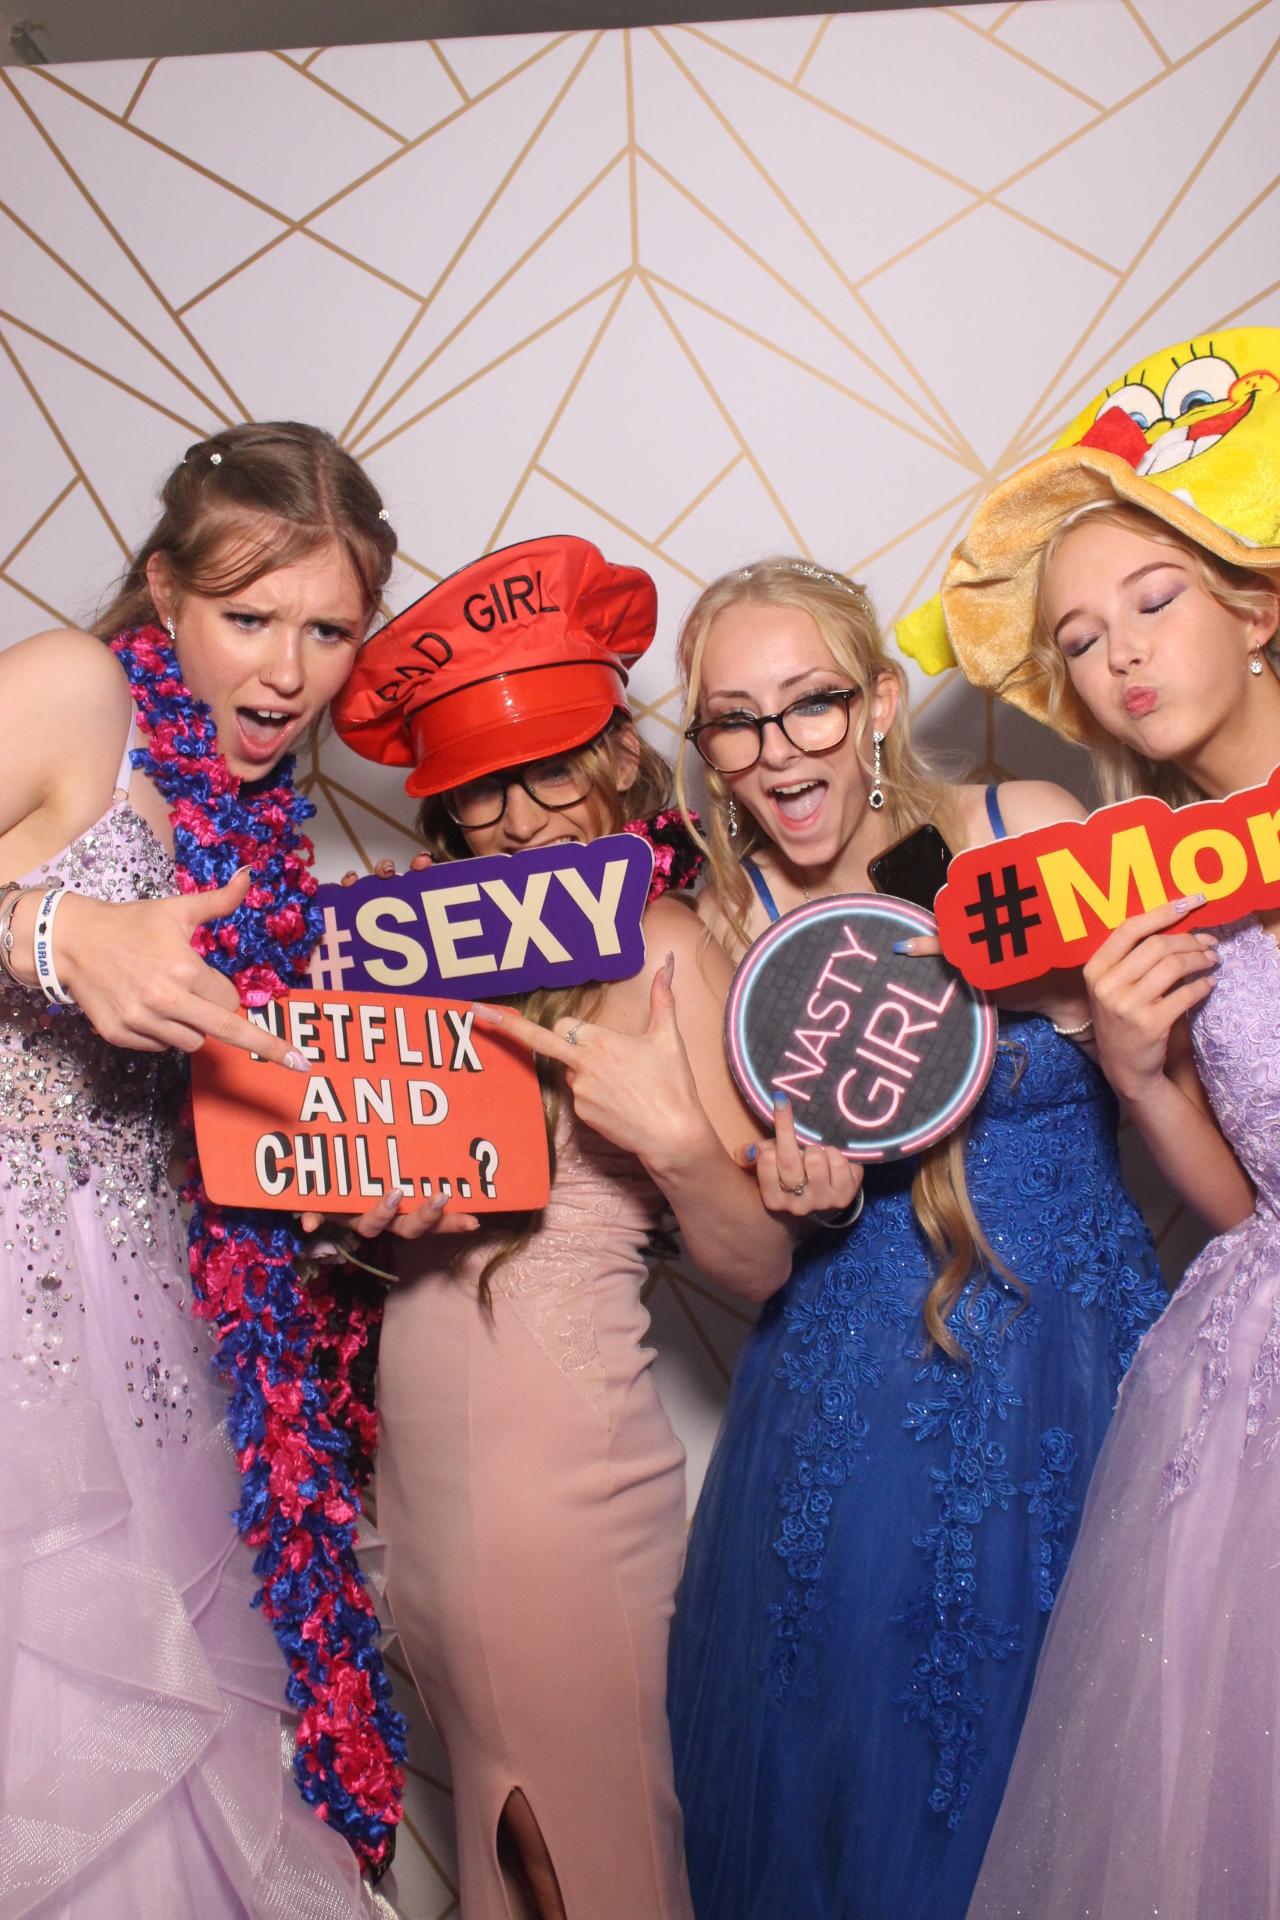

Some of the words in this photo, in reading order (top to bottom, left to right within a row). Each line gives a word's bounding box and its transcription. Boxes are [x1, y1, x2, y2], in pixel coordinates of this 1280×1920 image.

[463, 570, 560, 633] GIRL
[304, 858, 629, 990] #SEXY
[37, 941, 49, 976] GRAD
[771, 925, 878, 1101] NASTY
[836, 978, 957, 1128] GIRL
[299, 1075, 449, 1127] AND
[254, 1131, 500, 1199] CHILL...?
